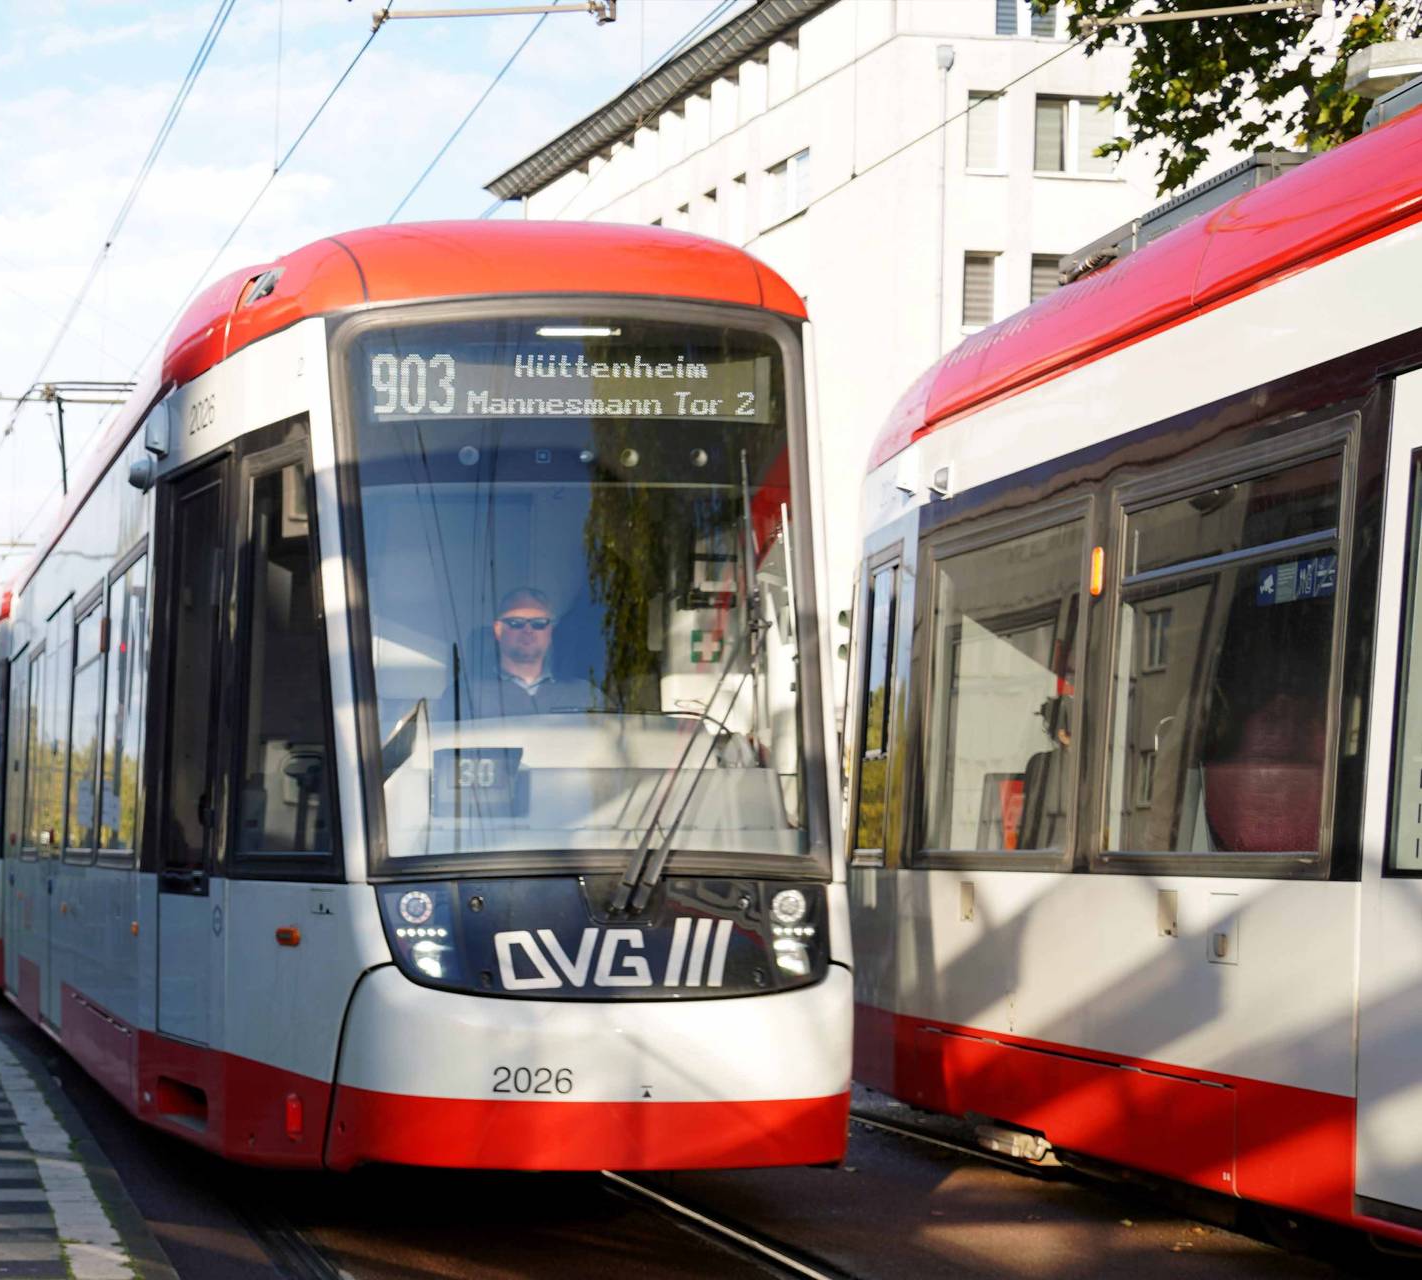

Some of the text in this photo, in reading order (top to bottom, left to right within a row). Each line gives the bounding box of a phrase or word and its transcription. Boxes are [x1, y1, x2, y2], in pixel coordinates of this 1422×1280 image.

[514, 354, 709, 379] Hüttenheim
[372, 354, 455, 414] 903
[189, 393, 215, 436] 2026
[467, 390, 755, 416] Mannesmann Tor 2
[458, 758, 495, 788] 30
[493, 1066, 573, 1094] 2026
